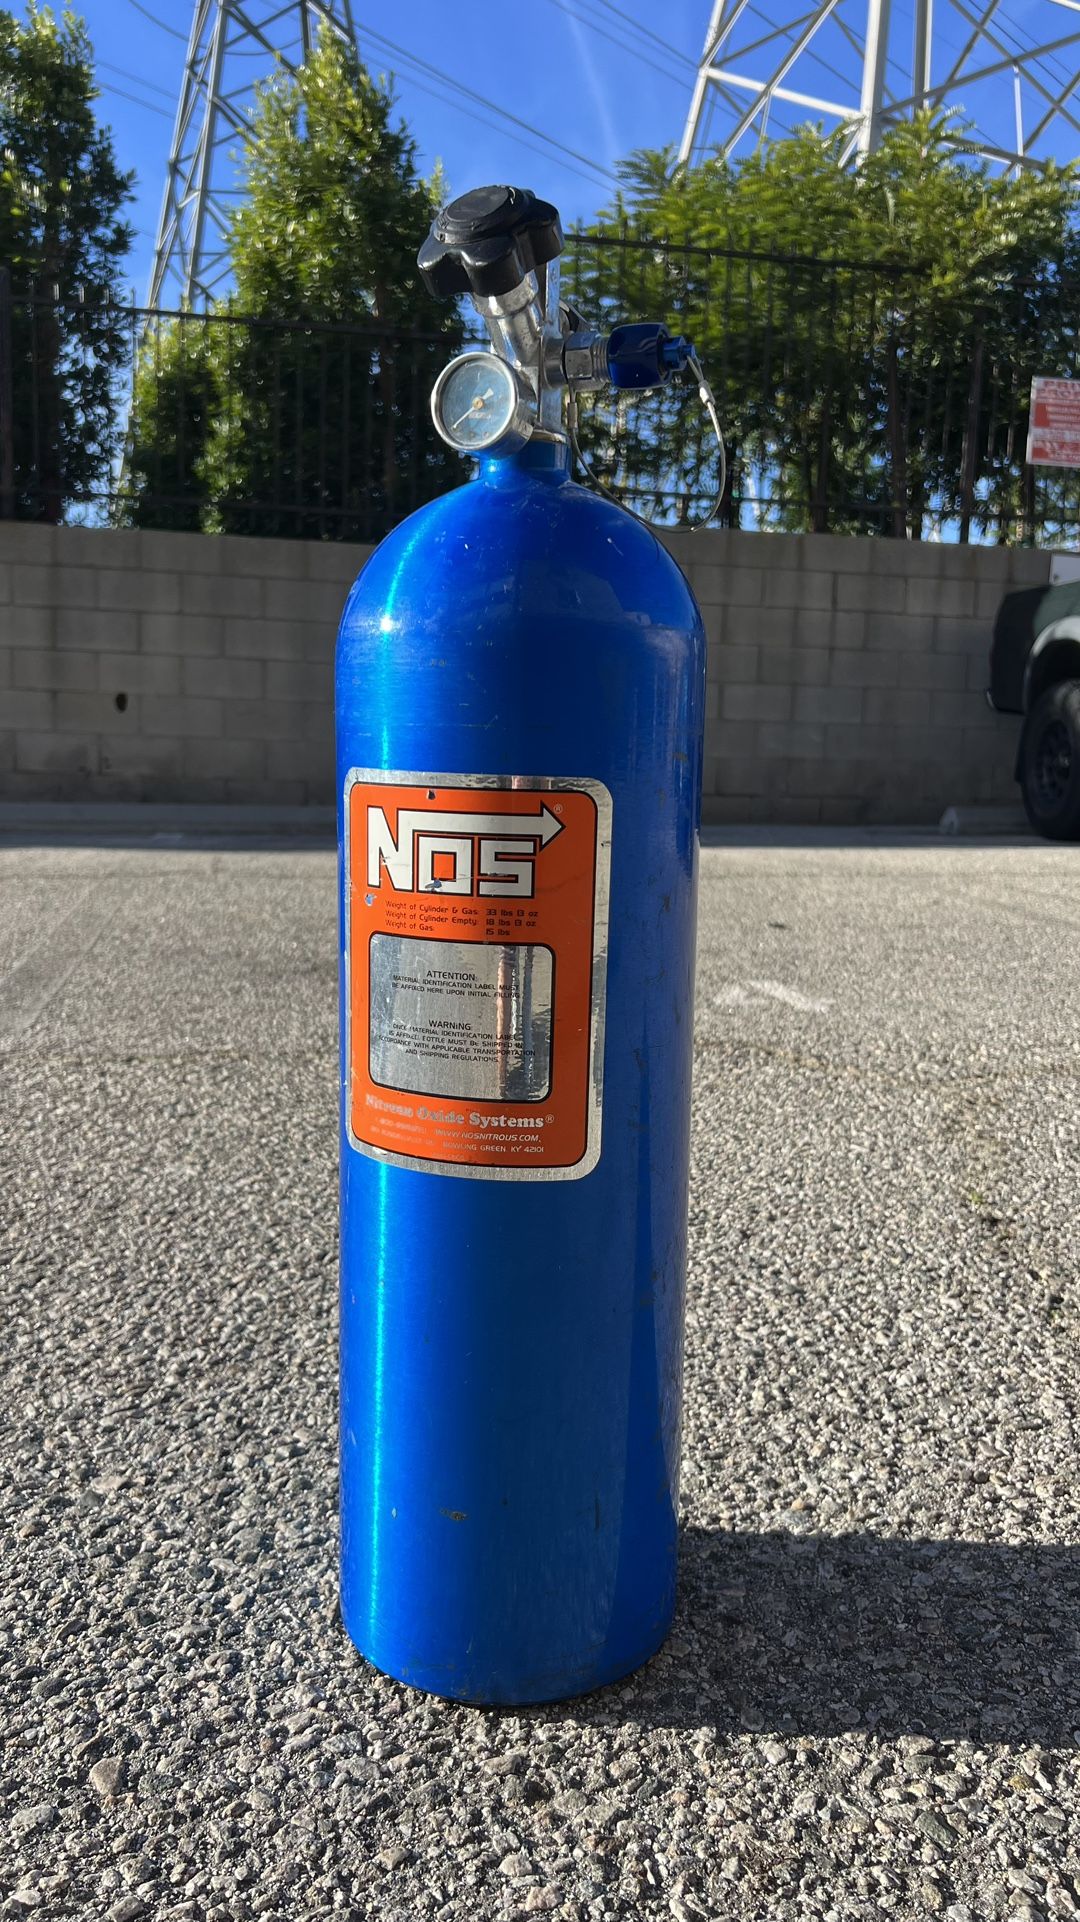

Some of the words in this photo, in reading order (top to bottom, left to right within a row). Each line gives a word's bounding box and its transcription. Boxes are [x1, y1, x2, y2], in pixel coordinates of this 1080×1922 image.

[385, 900, 407, 910] Weight
[419, 904, 449, 913] Cylinder
[451, 906, 458, 914] &
[485, 908, 497, 916] 33
[500, 909, 513, 917] lbs
[385, 910, 407, 920] Weight
[419, 913, 449, 923] Cylinder
[485, 918, 495, 926] 18
[498, 918, 511, 926] lbs
[385, 919, 407, 929] Weight
[497, 928, 511, 936] lbs
[392, 974, 418, 983] MATERIAL
[422, 978, 472, 989] IDENTIFICATION
[400, 983, 425, 992] AFFIXED
[426, 987, 444, 995] HERE
[446, 988, 465, 996] UPON
[467, 990, 492, 998] INITIAL
[392, 1023, 407, 1031] ONCE
[441, 1030, 493, 1040] IDENTIFICATION
[413, 1042, 430, 1050] WITH
[431, 1044, 471, 1054] APPLICABLE
[472, 1047, 536, 1057] TRANSPORTATION
[447, 1038, 467, 1046] MUST
[404, 1048, 418, 1056] AND
[419, 1050, 450, 1060] SHIPPING
[480, 1143, 506, 1153] GREEN
[510, 1144, 522, 1153] KY
